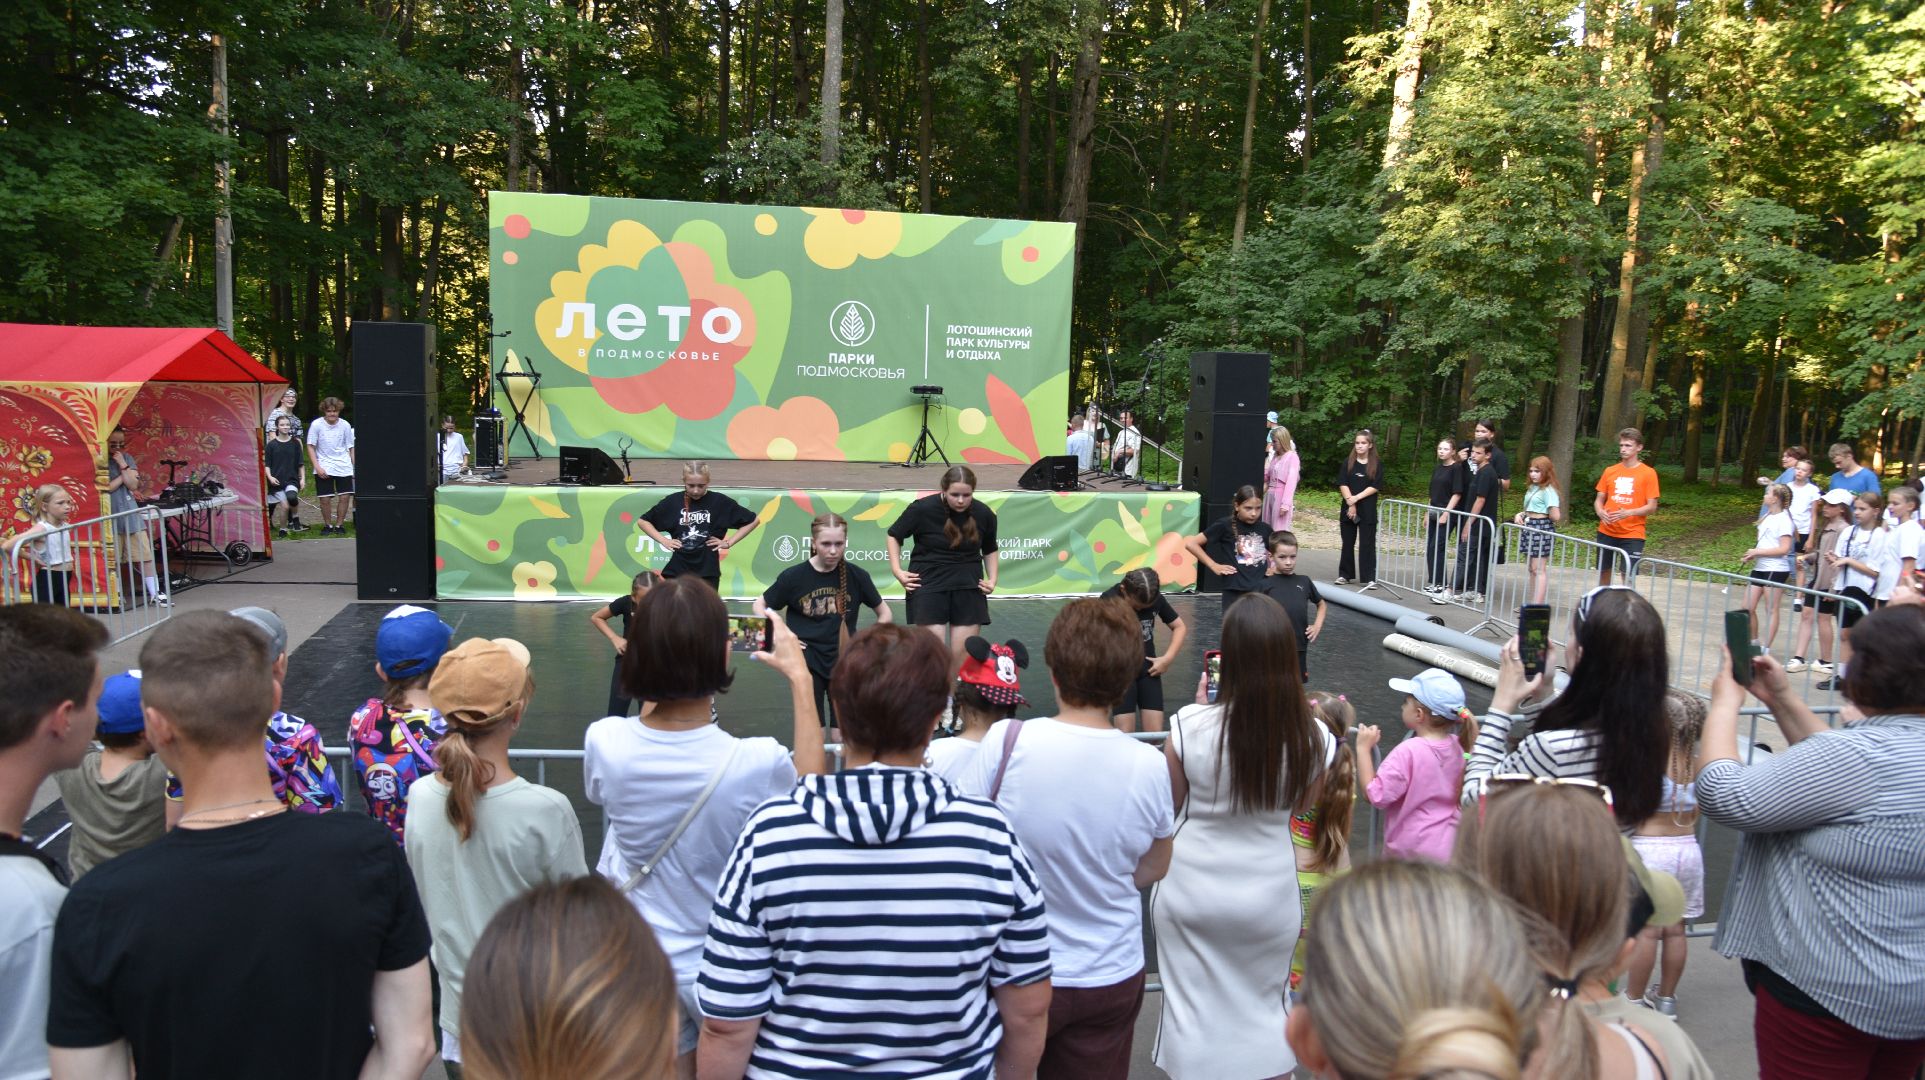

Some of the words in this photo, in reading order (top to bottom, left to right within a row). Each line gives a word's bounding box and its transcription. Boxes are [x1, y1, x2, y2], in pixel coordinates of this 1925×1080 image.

[946, 325, 1032, 337] ЛОТОШИНСКИЙ
[946, 338, 975, 347] ПАРК
[977, 338, 1030, 349] КУЛЬТУРЫ
[596, 348, 720, 361] ПОДМОСКОВЬЕ
[829, 353, 875, 365] ПАРКИ
[946, 349, 954, 358] И
[956, 350, 1001, 360] ОТДЫХА
[797, 365, 905, 379] ПОДМОСКОВЬЯ
[1023, 538, 1052, 548] ПАРК
[1000, 550, 1044, 560] ОТДЫХА
